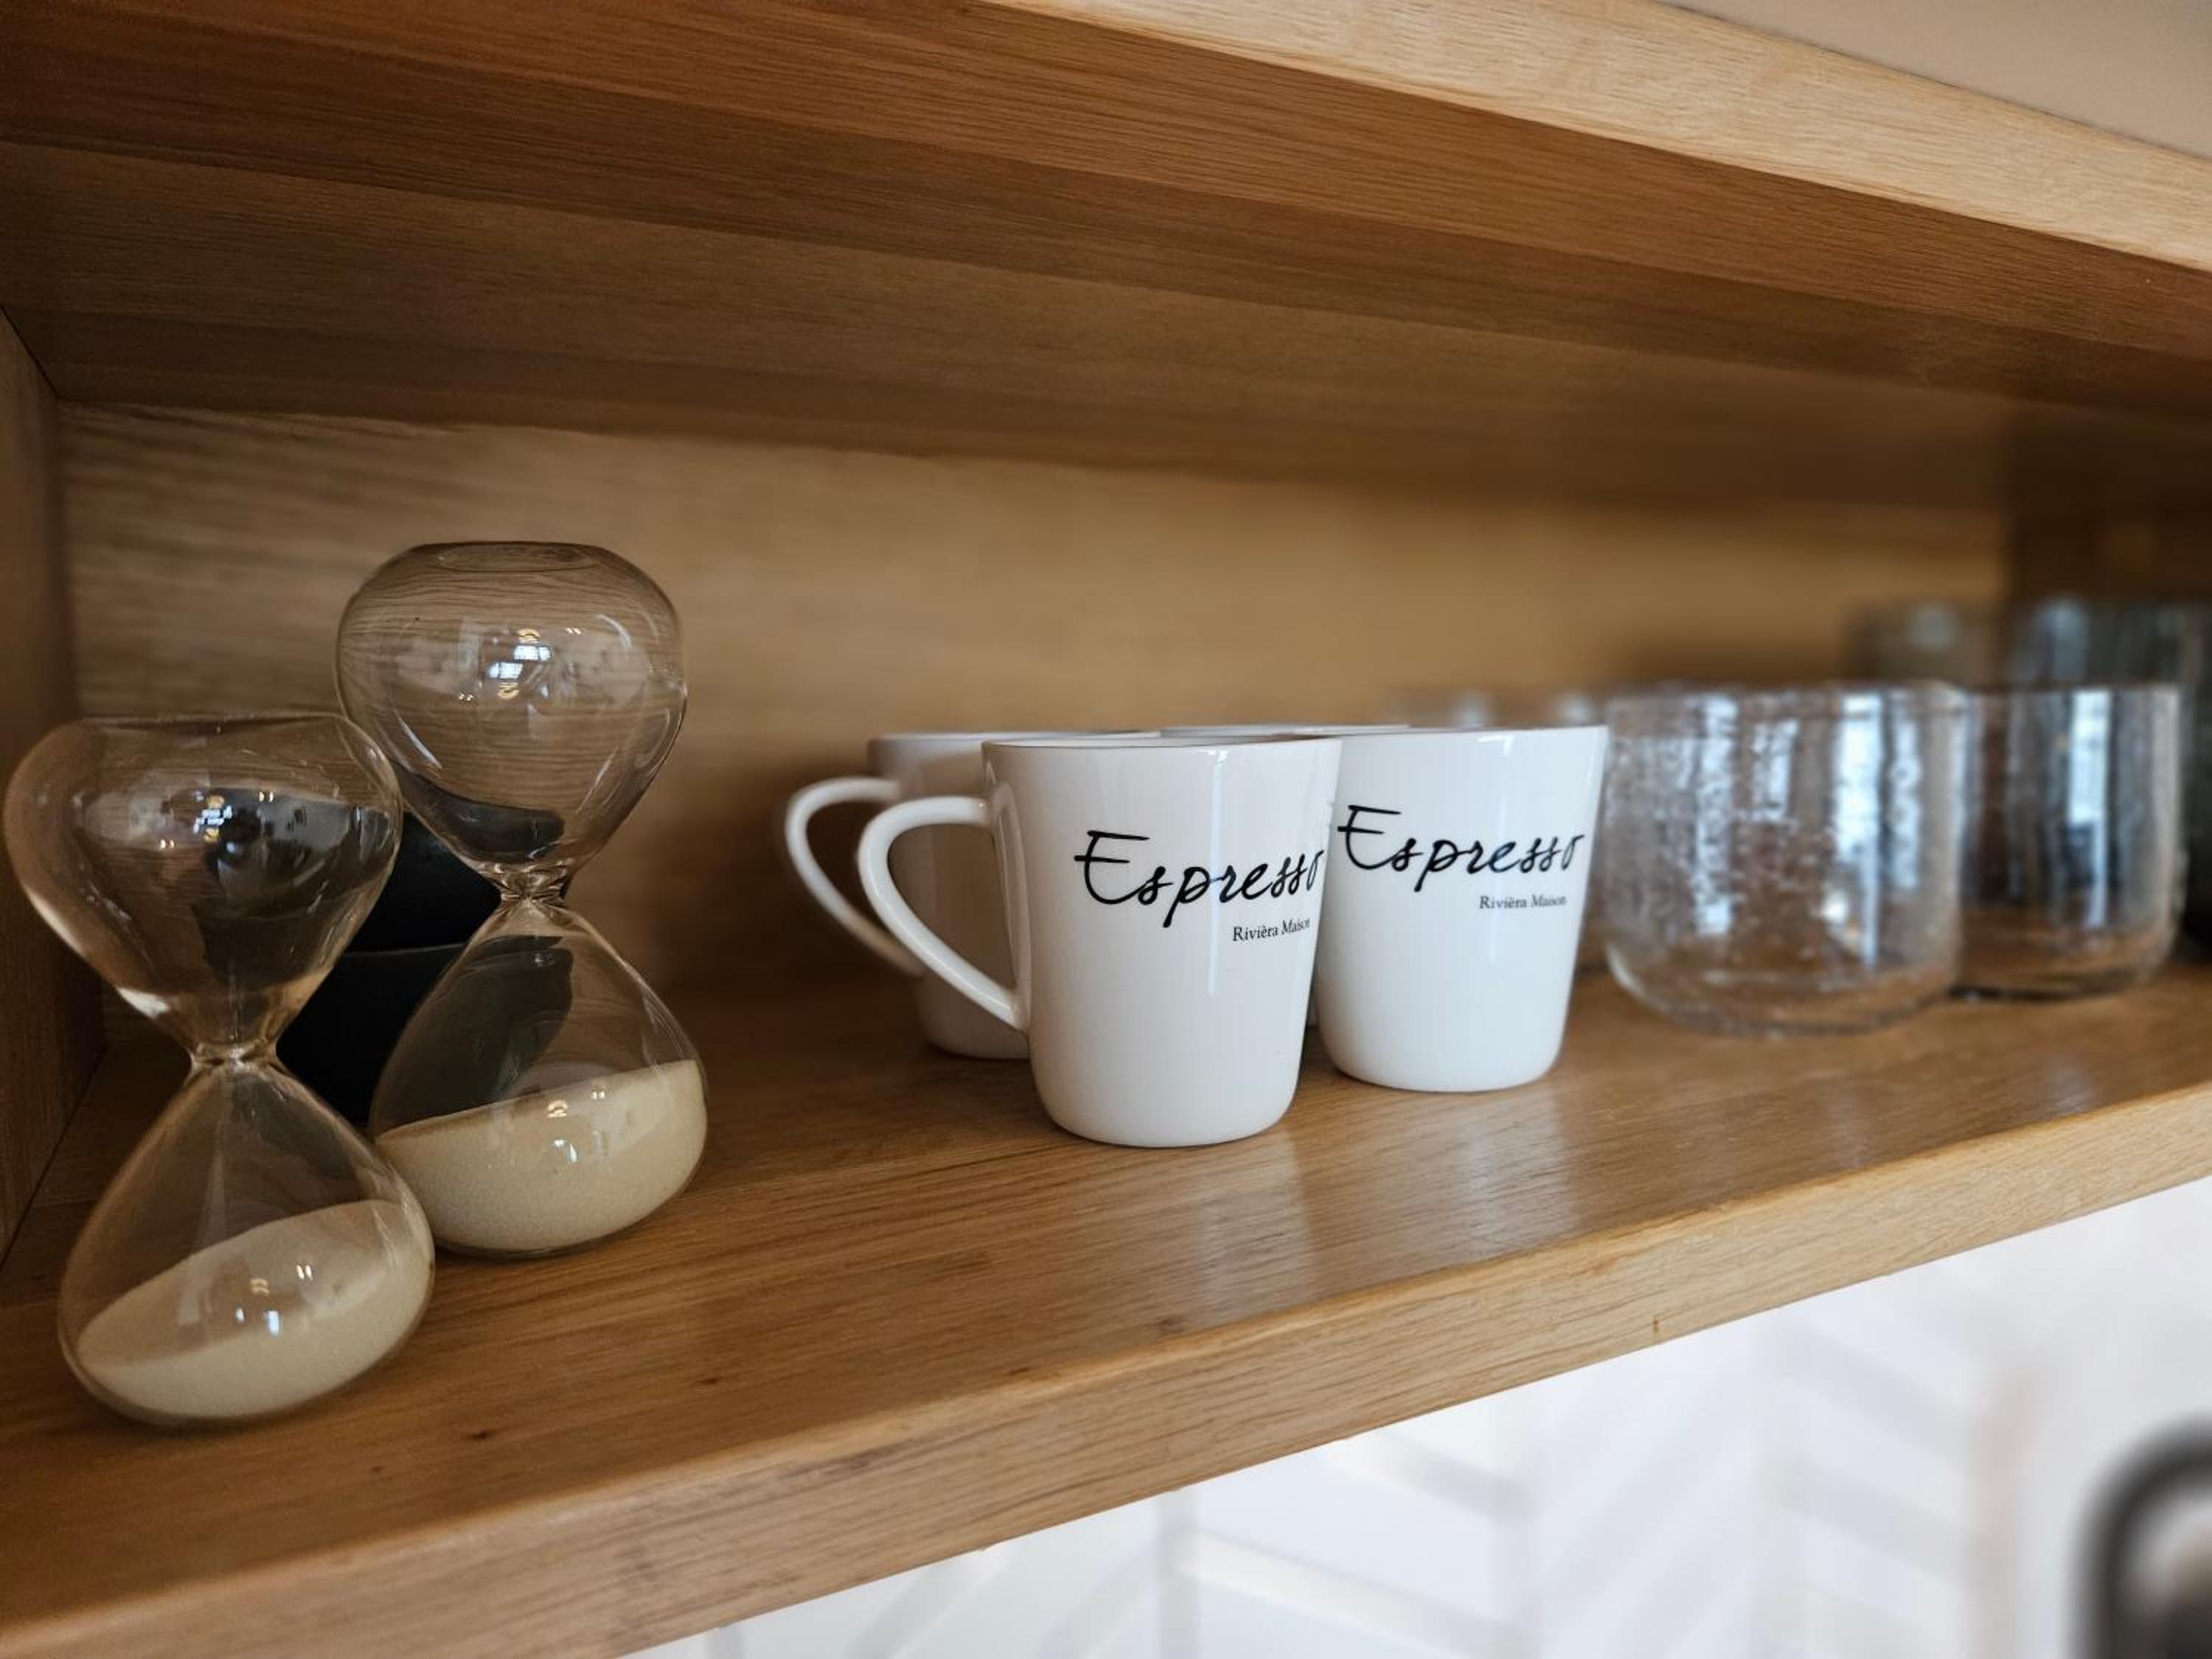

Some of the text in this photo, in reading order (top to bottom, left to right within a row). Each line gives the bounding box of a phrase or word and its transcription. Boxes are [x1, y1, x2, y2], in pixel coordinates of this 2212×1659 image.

[1074, 830, 1325, 928] Espresso
[1337, 804, 1585, 893] Espresso
[1232, 918, 1310, 942] Rivièra Maison
